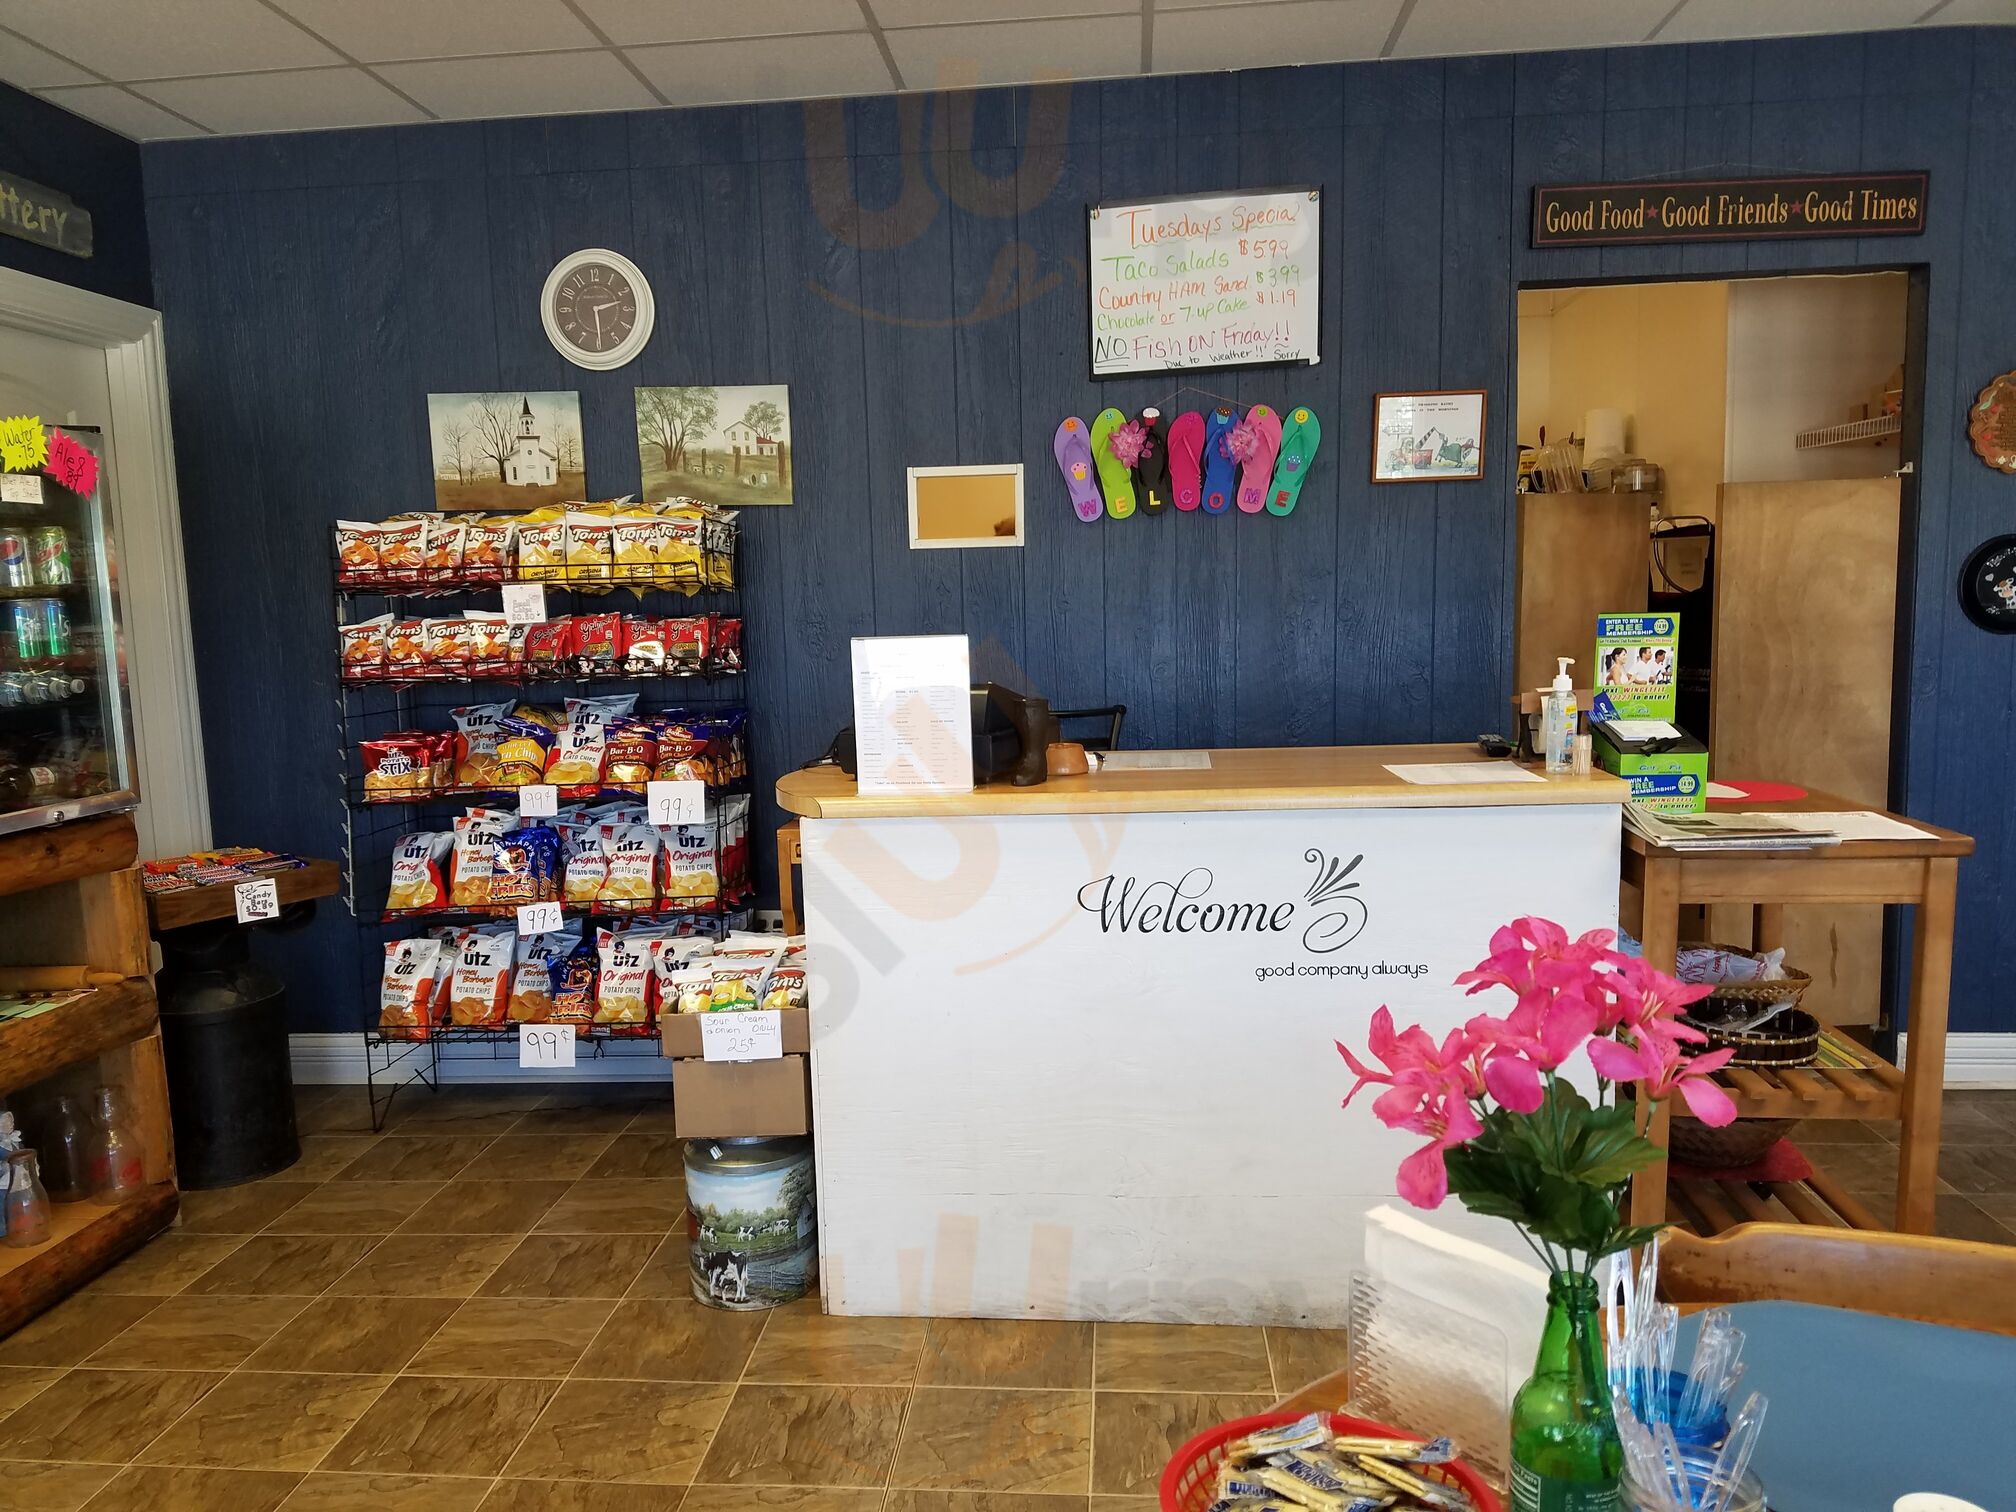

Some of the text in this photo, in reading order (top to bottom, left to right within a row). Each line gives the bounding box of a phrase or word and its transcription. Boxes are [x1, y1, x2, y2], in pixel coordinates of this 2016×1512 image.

[1546, 189, 1918, 233] Good Food Good Friends Good Times
[1101, 249, 1229, 282] Taco Salads
[590, 268, 599, 282] 12
[1099, 286, 1162, 312] Country
[1097, 297, 1250, 332] Chocolate or Cake
[1095, 335, 1129, 363] NO
[1132, 336, 1182, 360] Fish
[1188, 331, 1216, 352] ON
[1164, 358, 1186, 370] Due
[1189, 355, 1200, 366] to
[1273, 349, 1301, 361] Sorry
[3, 428, 36, 447] Water
[468, 527, 507, 542] Tom's
[523, 530, 562, 546] Tom's
[572, 529, 610, 543] Tom's
[430, 624, 468, 639] Tom's
[469, 622, 509, 636] Tom's
[1606, 624, 1643, 632] FREE
[467, 714, 494, 727] utz
[380, 761, 411, 775] STIX
[1631, 785, 1677, 795] MEMBERSHIP
[467, 832, 494, 846] utz
[577, 839, 599, 852] tz
[617, 840, 645, 852] utz
[679, 834, 708, 848] utz
[610, 853, 651, 865] Original
[672, 850, 713, 864] Original
[632, 868, 648, 876] CHIPS
[245, 891, 272, 900] Candy
[1077, 867, 1295, 933] Welcome
[464, 952, 492, 966] utz
[394, 962, 417, 975] utz
[456, 968, 478, 977] Honey
[1255, 960, 1429, 981] good company always
[462, 975, 495, 986] Barbeque
[518, 979, 536, 987] POTATO
[456, 986, 491, 995] POTATO CHIPS
[604, 986, 641, 994] POTATO CHIPS
[706, 1013, 769, 1026] Sour Cream
[752, 1025, 777, 1036] ONLY
